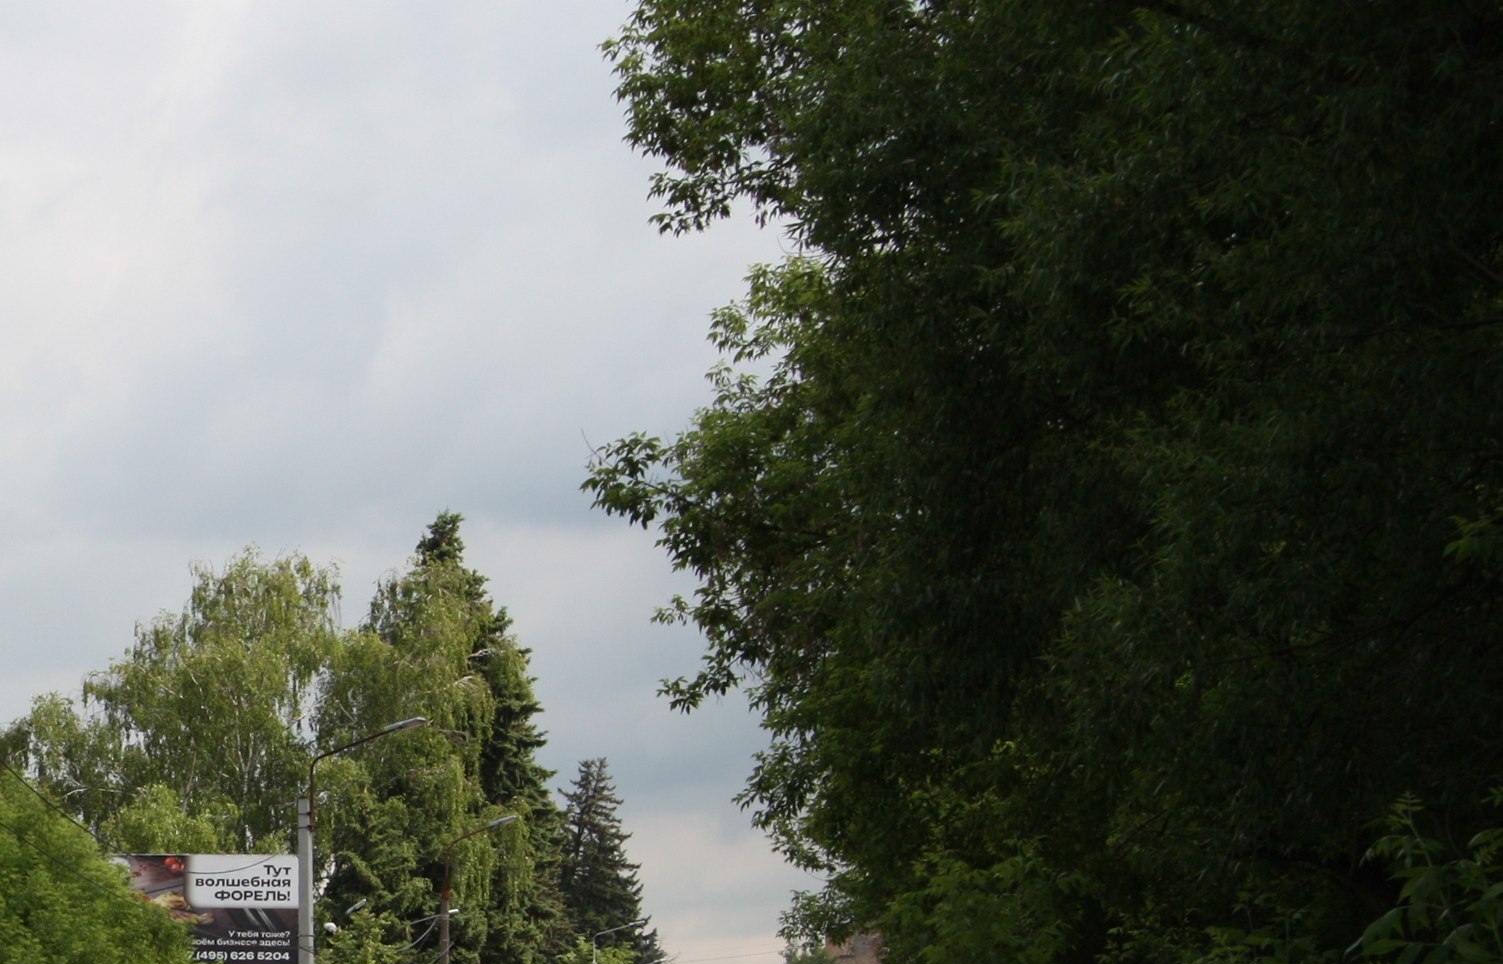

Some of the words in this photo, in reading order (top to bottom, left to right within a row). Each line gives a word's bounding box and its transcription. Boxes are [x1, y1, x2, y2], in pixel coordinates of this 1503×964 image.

[264, 864, 292, 877] Тут
[195, 877, 291, 888] волшебная
[214, 890, 291, 902] ФОРЕЛЬ!
[228, 930, 236, 938] У
[237, 930, 260, 938] тебя
[261, 930, 291, 938] тоже?
[259, 939, 291, 947] здесь!
[196, 951, 228, 961] (495)
[230, 951, 255, 961] 626
[257, 951, 290, 961] 5204
